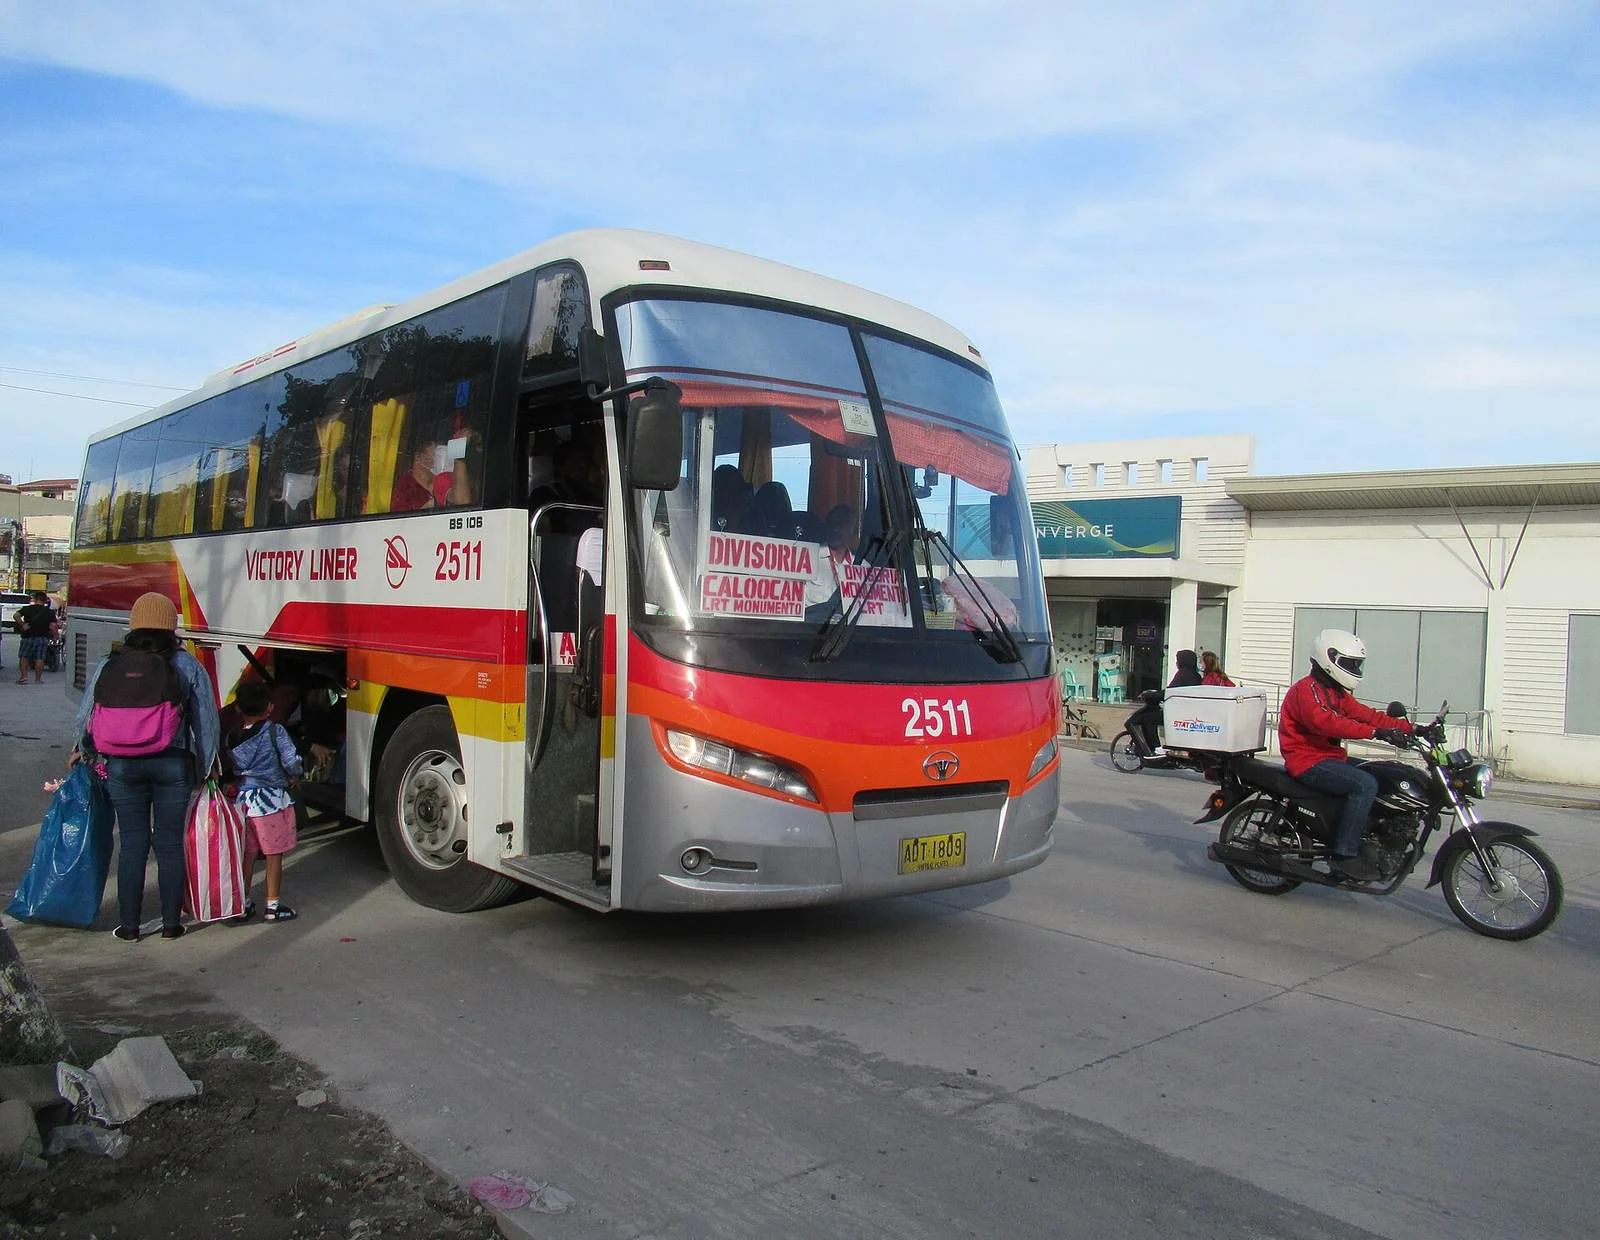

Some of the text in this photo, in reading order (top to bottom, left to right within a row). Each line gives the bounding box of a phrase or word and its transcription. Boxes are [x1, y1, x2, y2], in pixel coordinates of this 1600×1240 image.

[449, 517, 463, 530] BS
[1036, 524, 1114, 539] NVERGE
[246, 547, 358, 581] VICTORY LINER
[435, 540, 482, 582] 2511
[708, 535, 812, 574] DIVISORIA
[703, 575, 804, 602] CALOOCAN
[703, 597, 802, 615] LRT MONUMENTO
[901, 698, 973, 737] 2511
